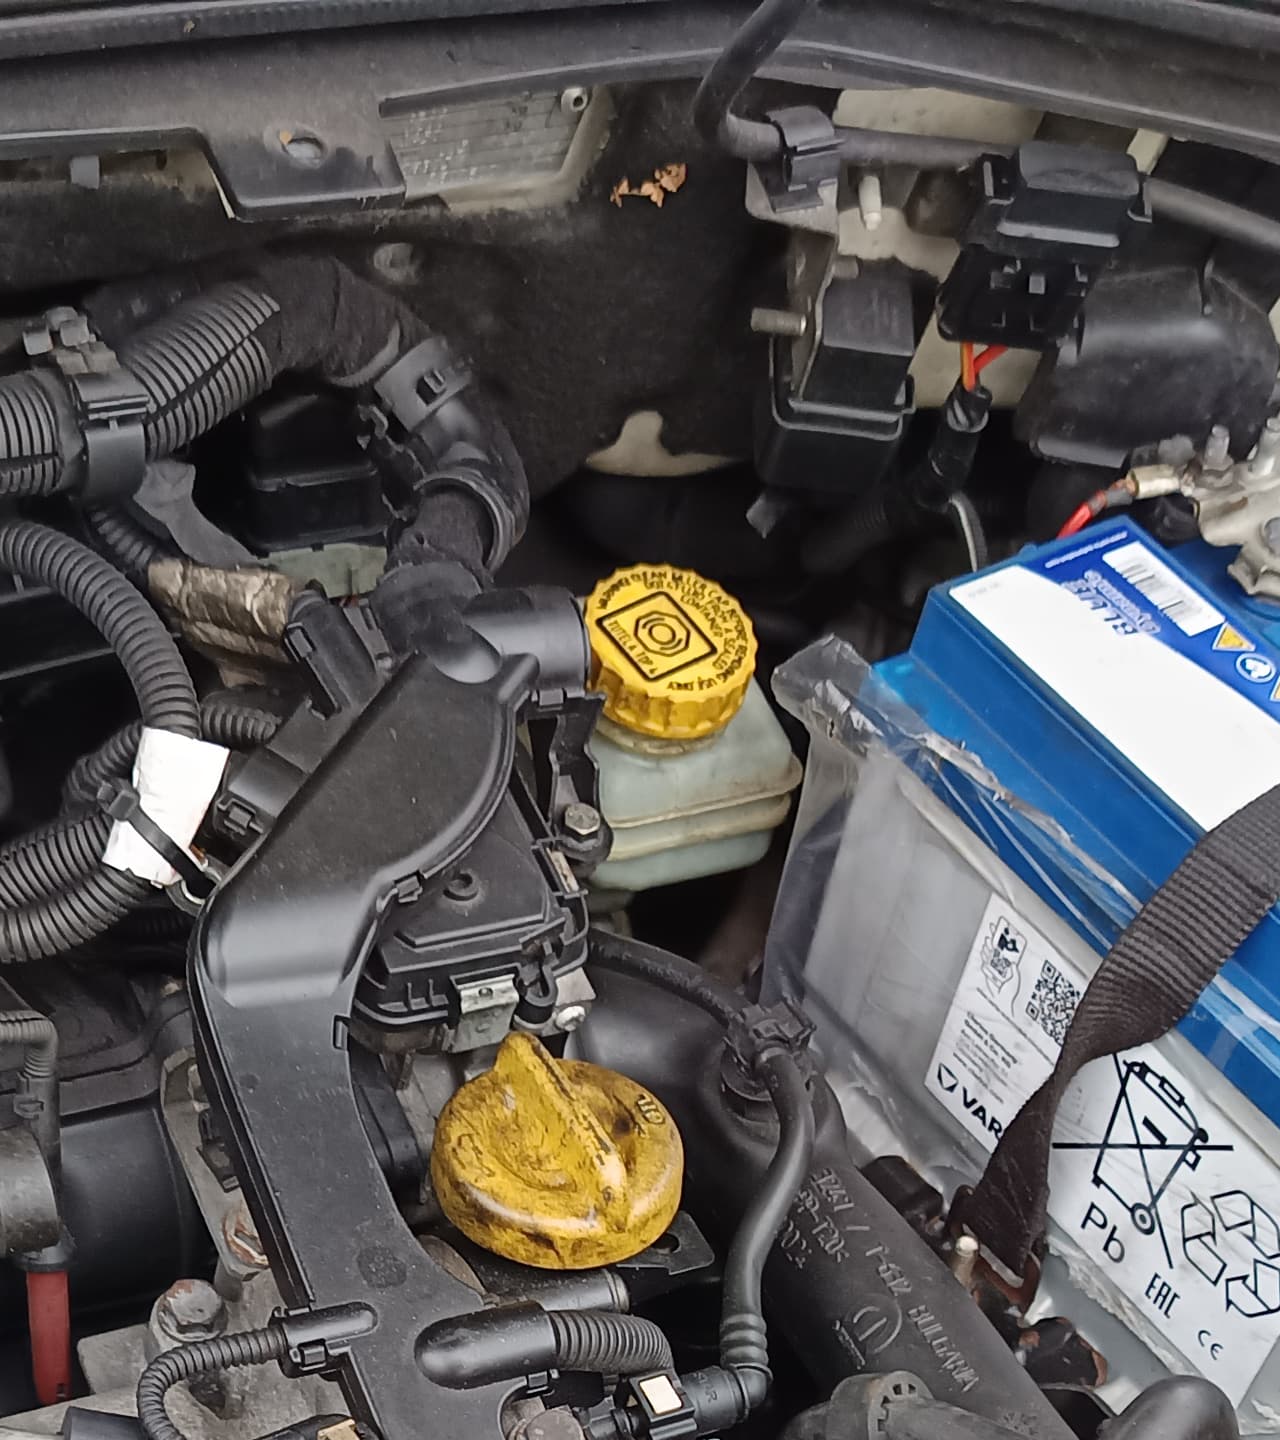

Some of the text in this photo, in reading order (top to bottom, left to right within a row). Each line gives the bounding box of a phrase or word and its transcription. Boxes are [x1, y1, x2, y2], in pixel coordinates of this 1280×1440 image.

[608, 620, 638, 652] TUTELA
[636, 1093, 666, 1125] OIL
[962, 1086, 1004, 1142] VAR
[1080, 1202, 1125, 1263] Pb
[1144, 1272, 1181, 1319] EAC
[908, 1304, 980, 1393] BULGARIA
[1198, 1330, 1224, 1361] CE
